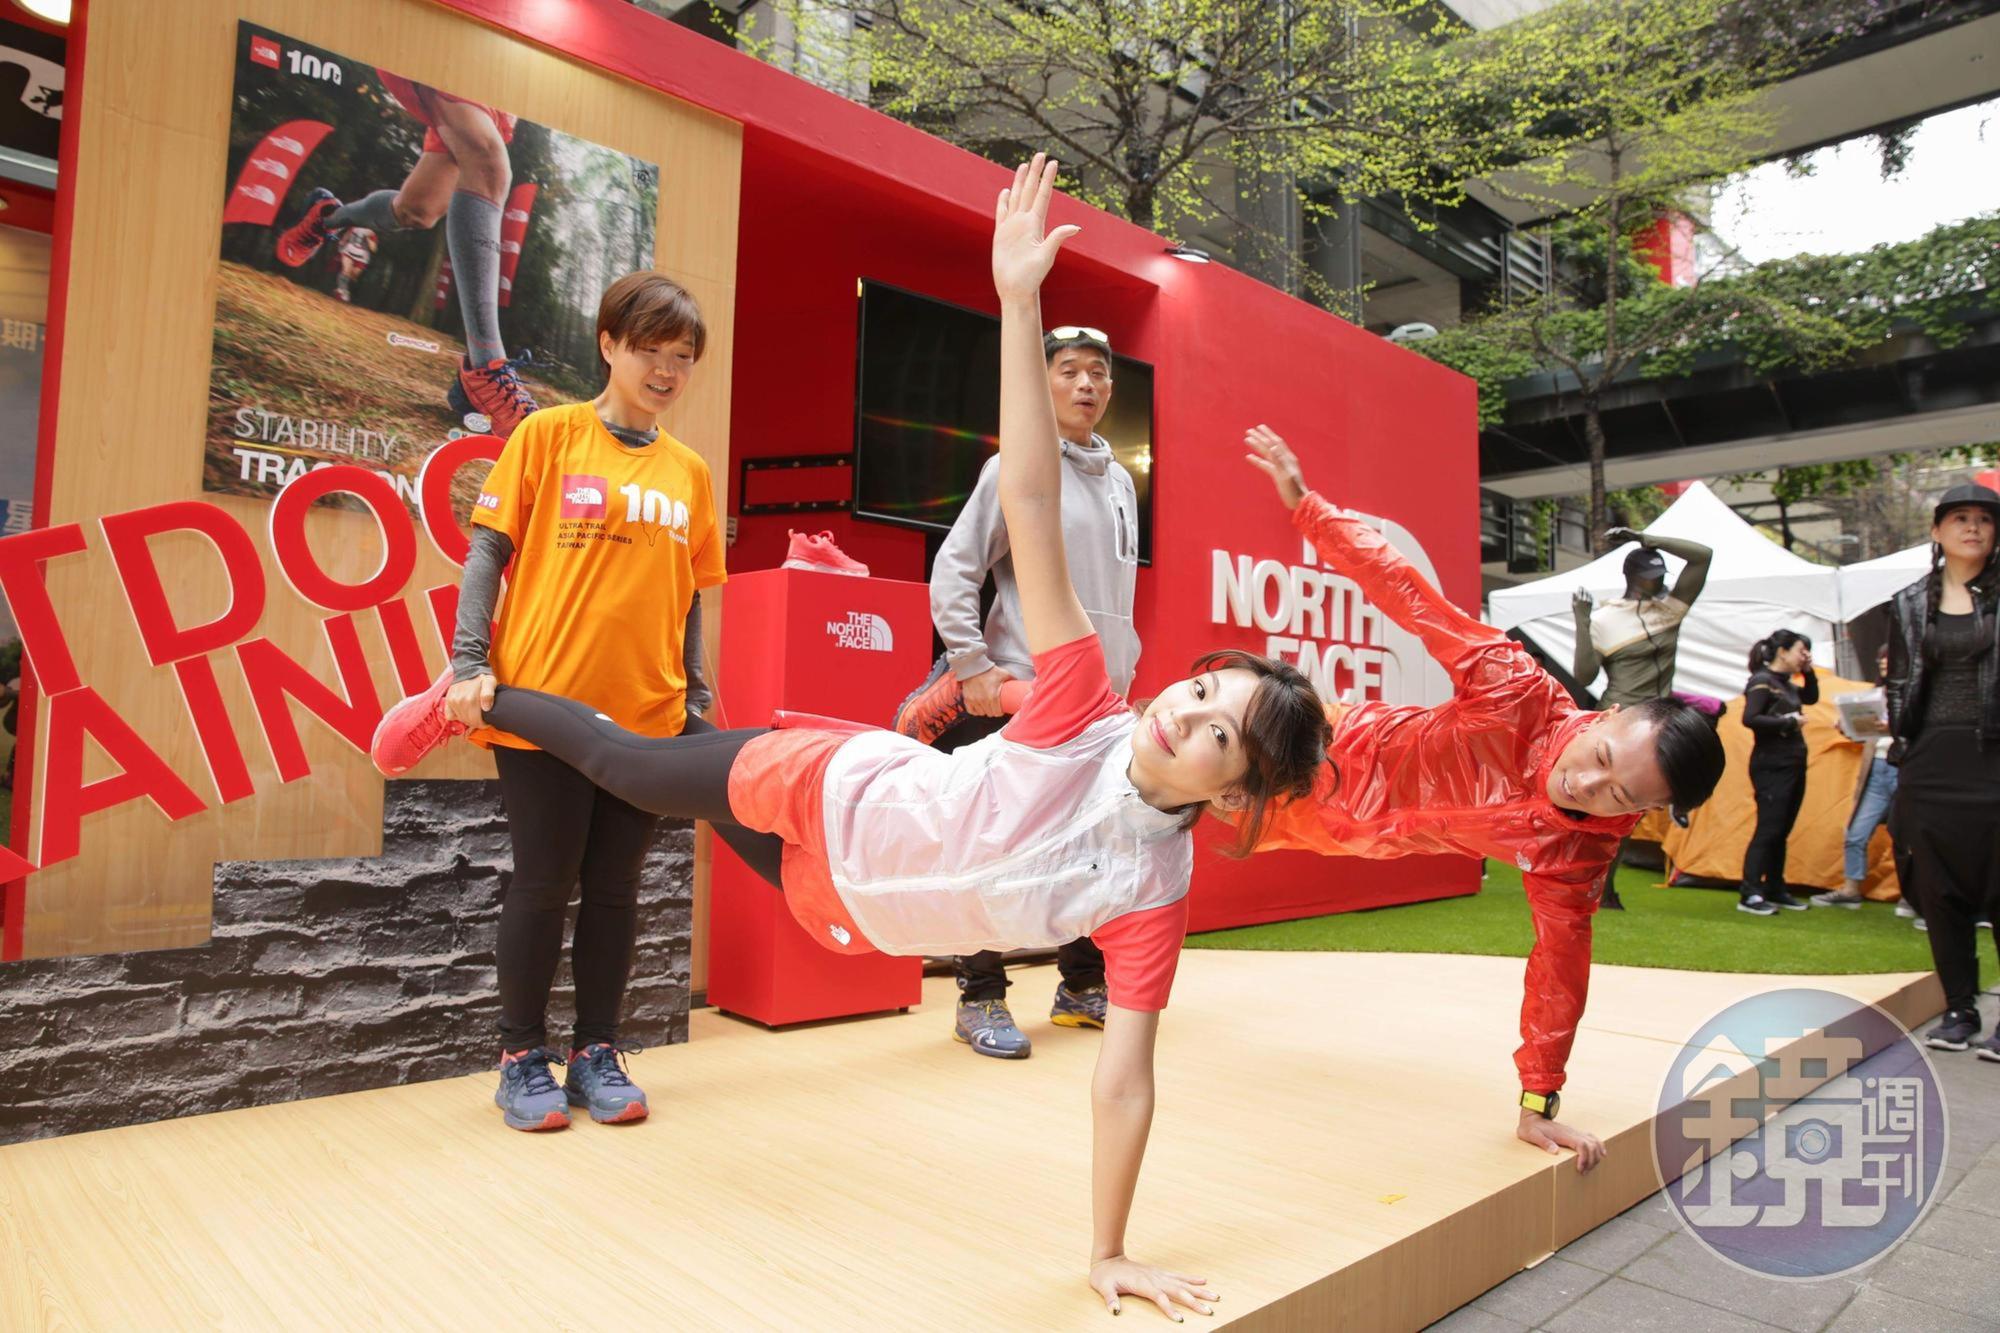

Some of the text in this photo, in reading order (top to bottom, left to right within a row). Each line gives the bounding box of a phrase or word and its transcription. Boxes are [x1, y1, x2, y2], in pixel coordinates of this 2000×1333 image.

[234, 408, 397, 460] STABILITY
[233, 448, 421, 505] TRAN
[607, 535, 632, 544] SERIES
[1212, 549, 1383, 647] NORTH
[847, 611, 871, 626] THE
[827, 621, 870, 637] NORTH
[839, 635, 870, 650] FACE
